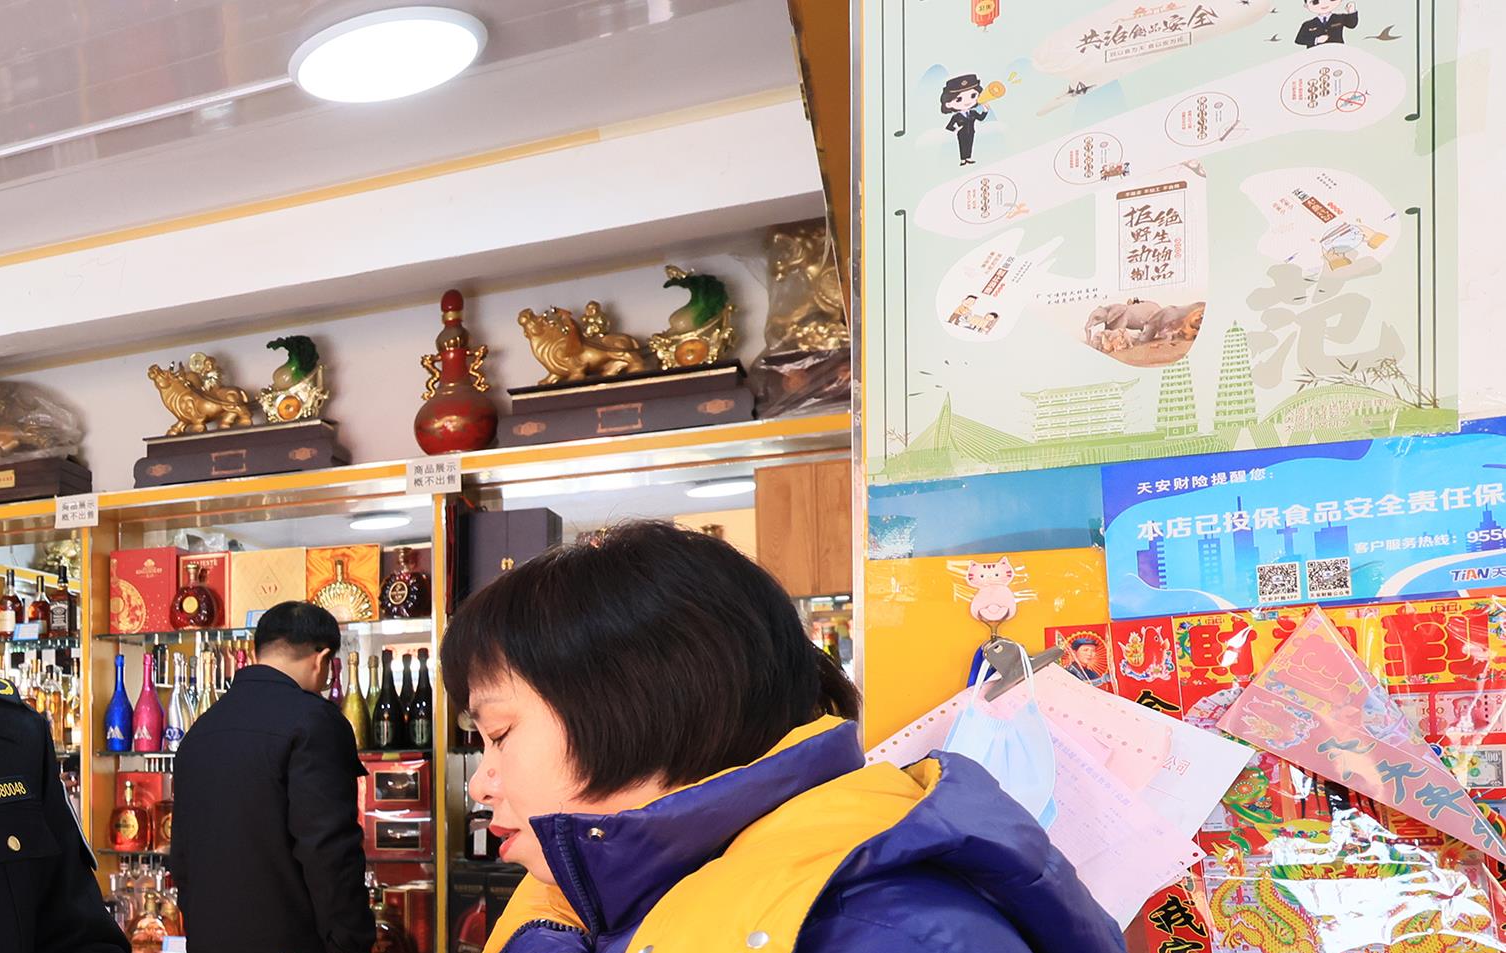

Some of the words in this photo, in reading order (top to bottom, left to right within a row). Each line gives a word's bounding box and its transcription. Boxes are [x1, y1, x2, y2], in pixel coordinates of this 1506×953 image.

[1076, 5, 1218, 53] 共治食品安全
[1123, 204, 1183, 228] 拒绝
[1130, 226, 1171, 246] 野生
[1127, 244, 1173, 263] 动物
[1130, 262, 1175, 281] 制品
[414, 462, 456, 475] 商品展示
[413, 474, 456, 487] 概不出售
[1137, 468, 1274, 495] 天安财险提醒您：
[1137, 483, 1506, 543] 本店已投保食品安全责任保
[1354, 534, 1457, 554] 客户服务热线：
